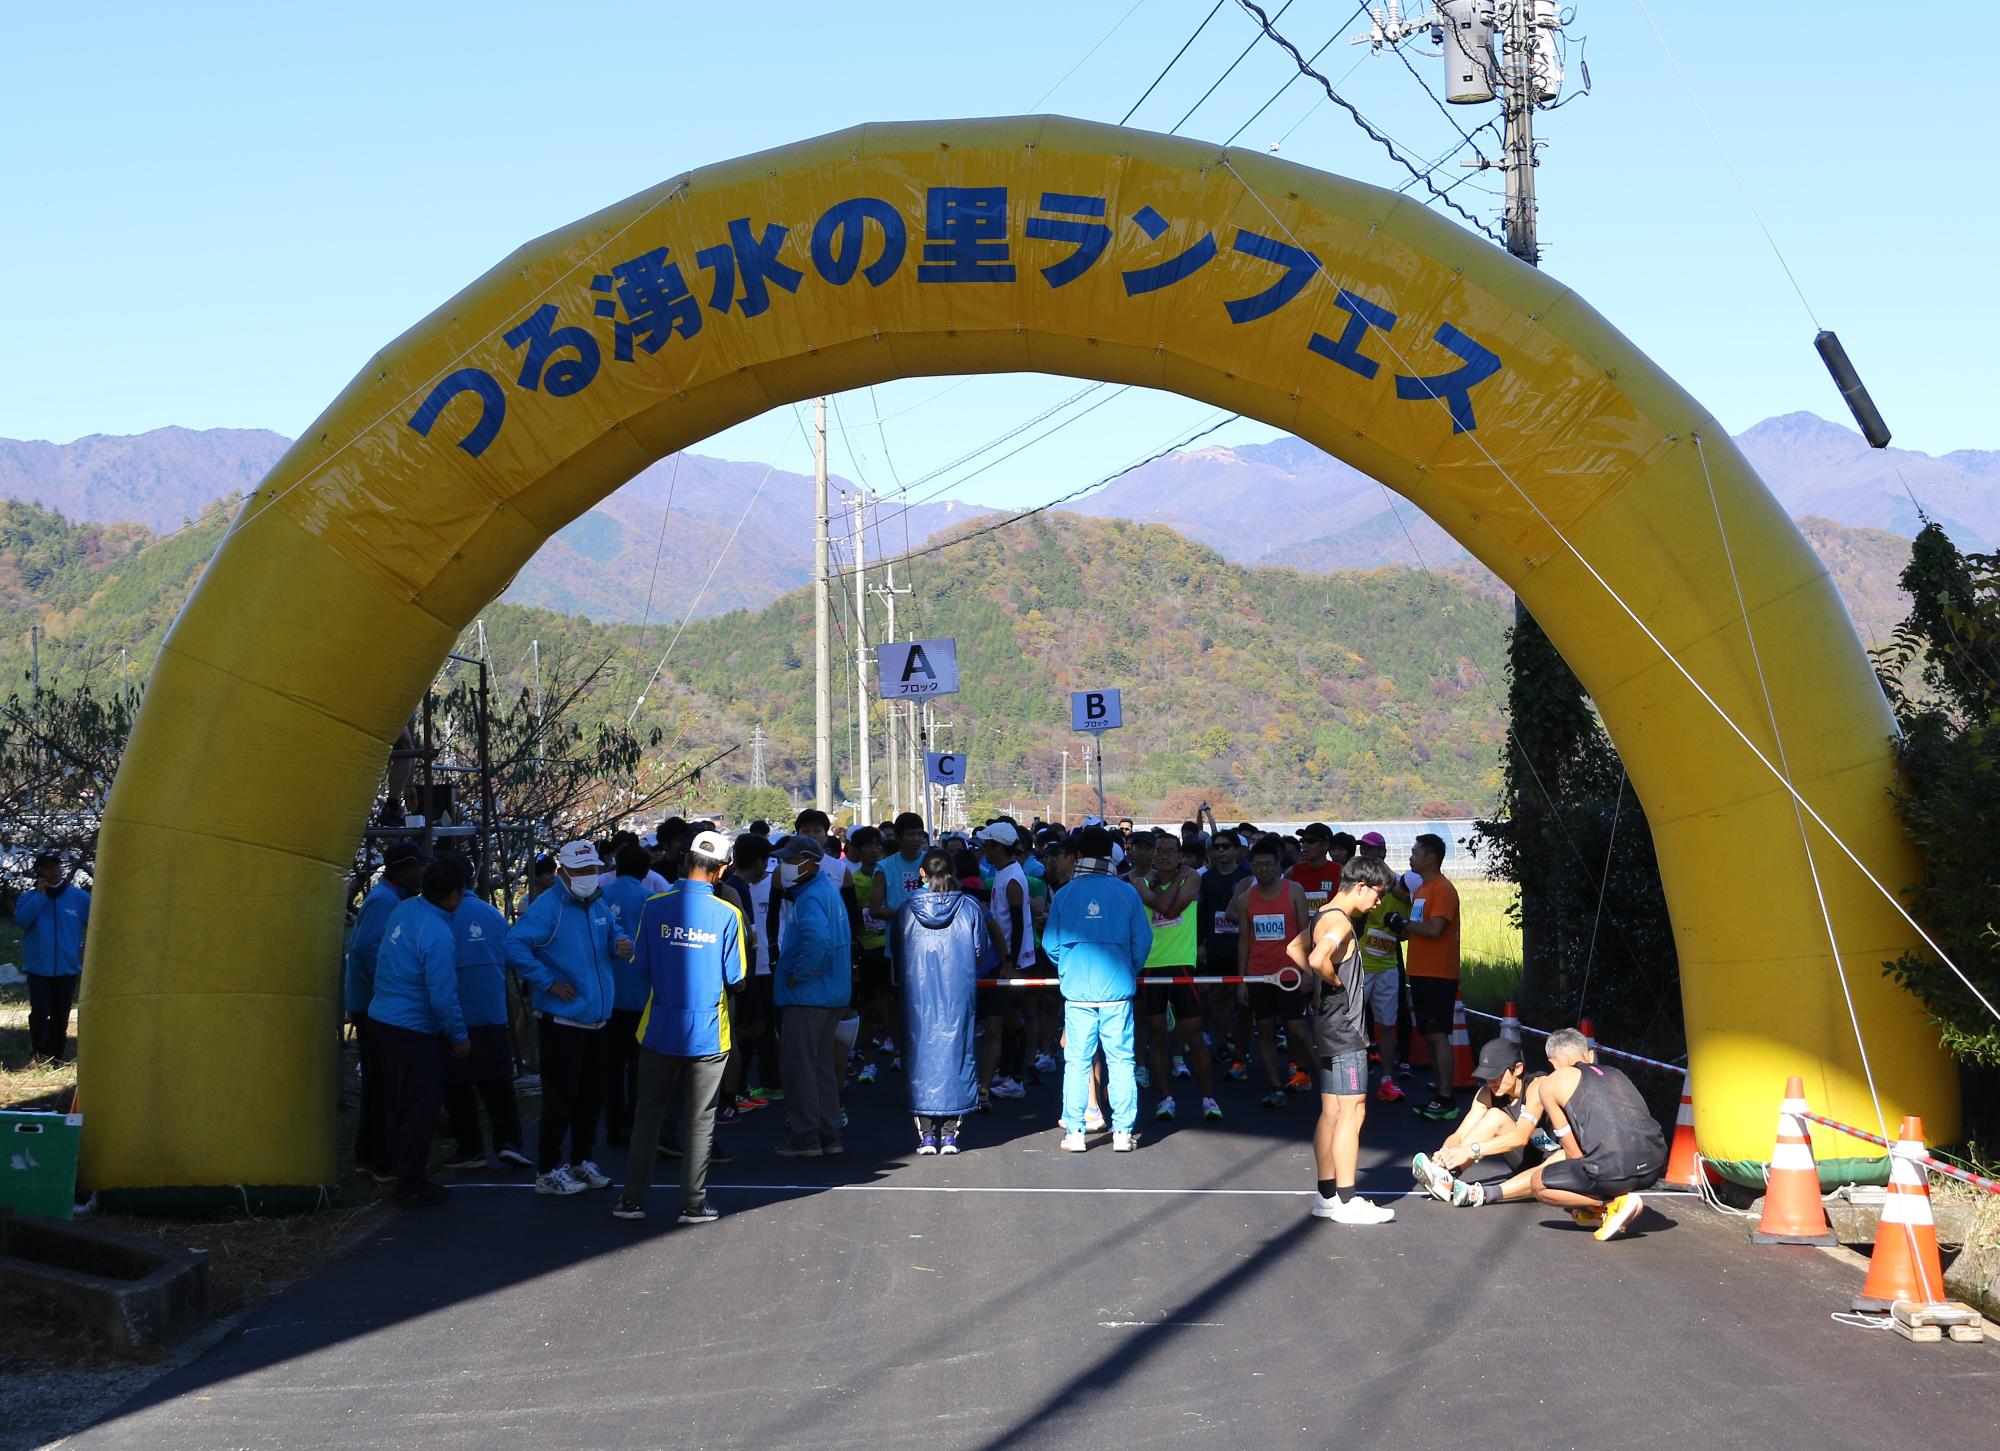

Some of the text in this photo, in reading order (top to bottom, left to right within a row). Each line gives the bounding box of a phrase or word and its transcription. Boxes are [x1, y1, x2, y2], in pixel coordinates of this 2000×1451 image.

[406, 187, 1502, 458] つる湧水の里ランフェス
[901, 645, 936, 681] A
[900, 682, 938, 694] ブロック
[1087, 693, 1106, 719] B
[1084, 720, 1108, 728] ブロック
[938, 755, 955, 775] C
[673, 926, 718, 944] R-bies
[1255, 921, 1284, 933] A1004
